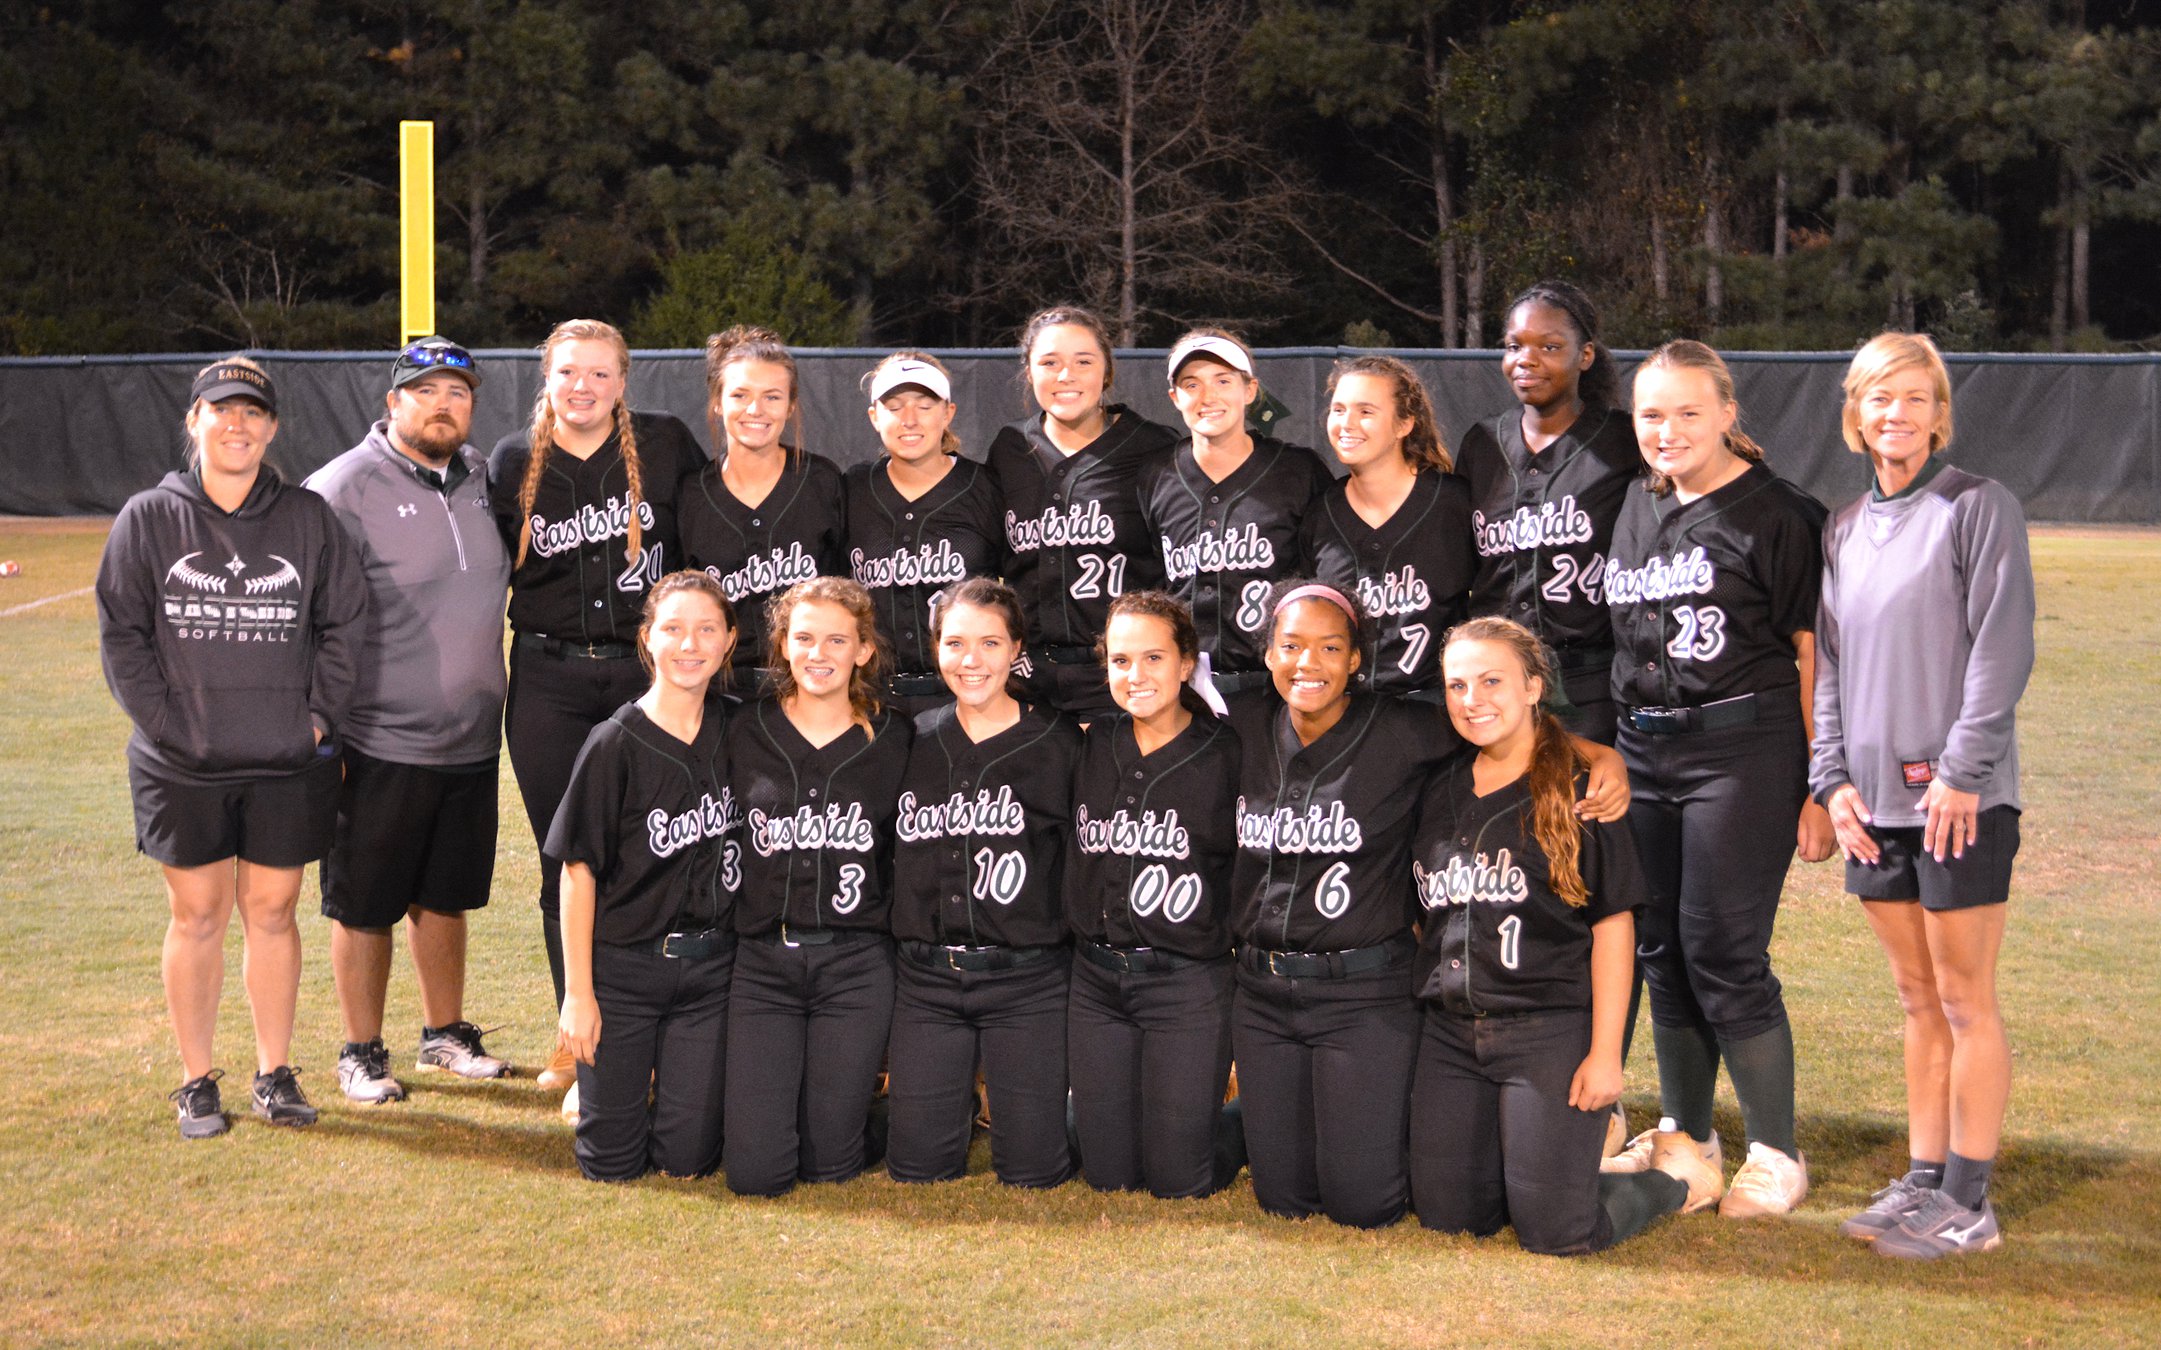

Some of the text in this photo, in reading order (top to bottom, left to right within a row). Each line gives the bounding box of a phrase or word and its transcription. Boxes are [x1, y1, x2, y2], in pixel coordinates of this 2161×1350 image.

[218, 367, 267, 389] EASTSIDE
[530, 490, 655, 558] Eastside
[1005, 499, 1116, 554] Eastside
[1472, 494, 1594, 557] Eastside
[616, 541, 663, 592] 20
[850, 538, 967, 590] Eastside
[1069, 553, 1128, 600] 21
[1161, 522, 1275, 582] Eastside
[1541, 552, 1606, 605] 24
[1603, 546, 1714, 607] Eastside
[1235, 579, 1273, 632] 8
[1356, 564, 1432, 618] tside
[178, 627, 289, 642] SOFTBALL
[1397, 623, 1431, 675] 7
[1667, 605, 1726, 662] 23
[749, 801, 873, 857] Eastside
[896, 784, 1026, 842] Eastside
[1236, 795, 1363, 854] Eastside
[721, 839, 743, 892] 3
[831, 863, 867, 914] 3
[972, 847, 1027, 905] 10
[1130, 863, 1203, 923] 00
[1314, 861, 1351, 919] 6
[1497, 914, 1522, 970] 1
